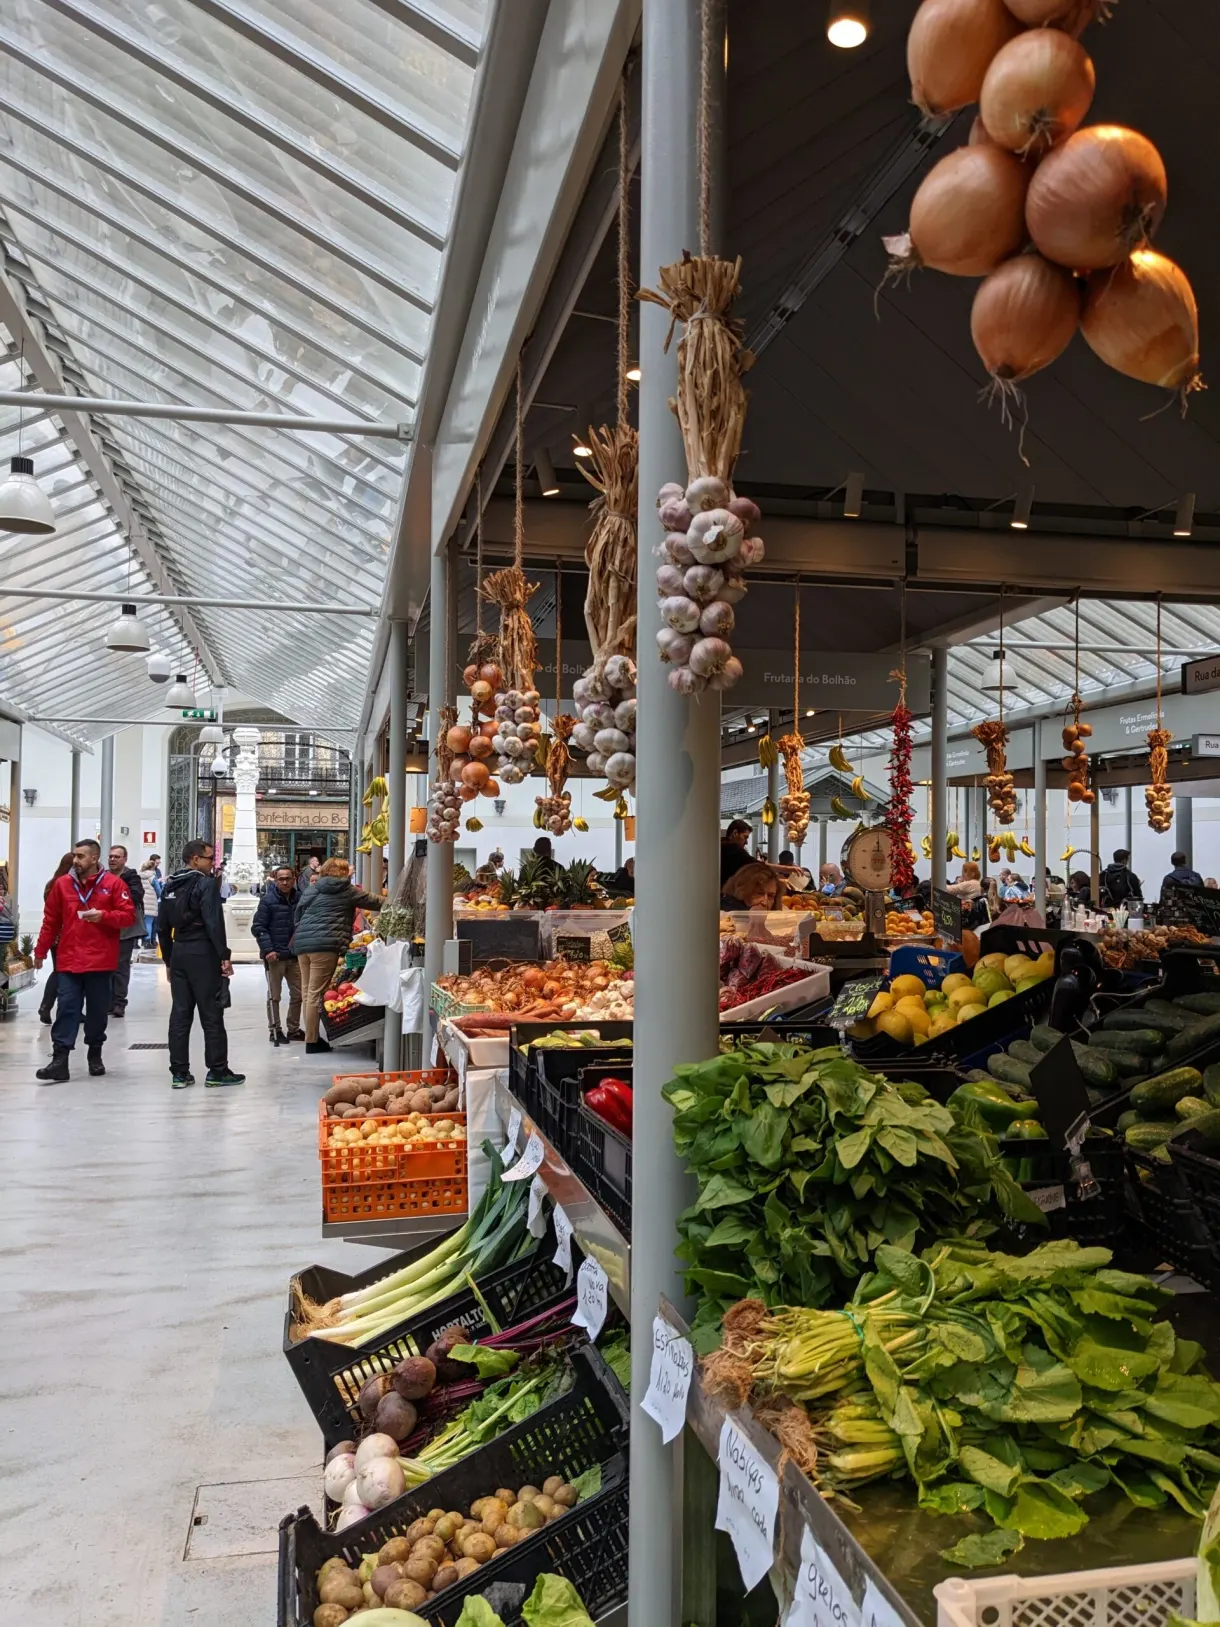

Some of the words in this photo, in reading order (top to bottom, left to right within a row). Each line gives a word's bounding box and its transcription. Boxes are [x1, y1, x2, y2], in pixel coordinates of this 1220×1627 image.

[562, 663, 586, 675] Bolh
[763, 672, 804, 684] Frutara
[806, 674, 820, 684] do
[822, 674, 857, 686] Bolhão
[1194, 670, 1209, 682] Rua
[1119, 716, 1136, 725] Frutas
[1205, 740, 1219, 750] Rua
[312, 812, 329, 824] do
